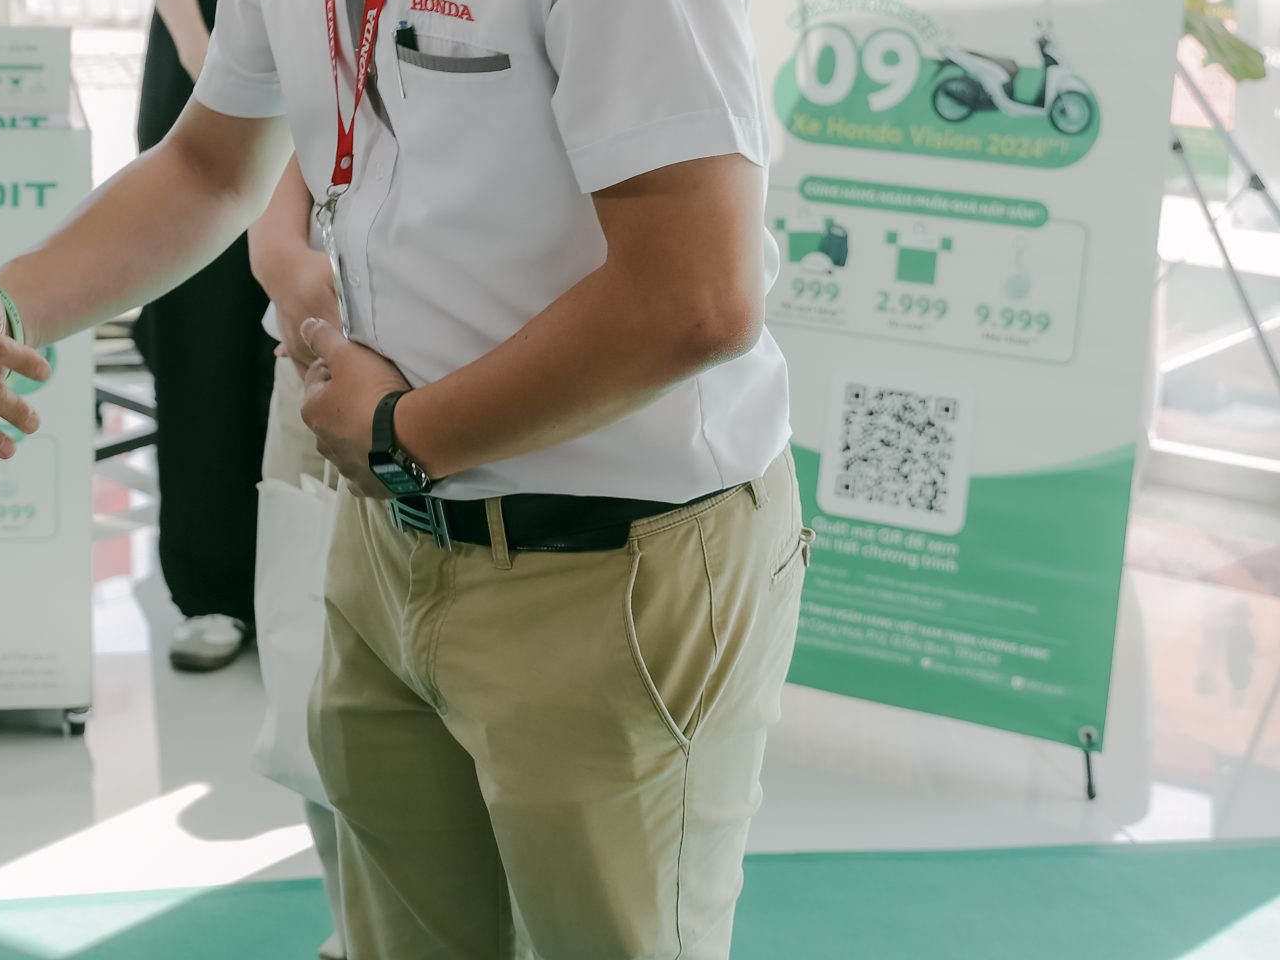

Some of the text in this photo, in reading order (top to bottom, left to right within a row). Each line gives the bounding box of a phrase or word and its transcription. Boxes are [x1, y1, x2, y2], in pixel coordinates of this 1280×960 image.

[795, 23, 920, 113] 09
[791, 113, 819, 135] Xe
[827, 115, 904, 142] Honda
[910, 125, 981, 152] Vision
[791, 278, 840, 302] 999
[876, 290, 949, 319] 2.999
[975, 304, 1051, 333] 9.999
